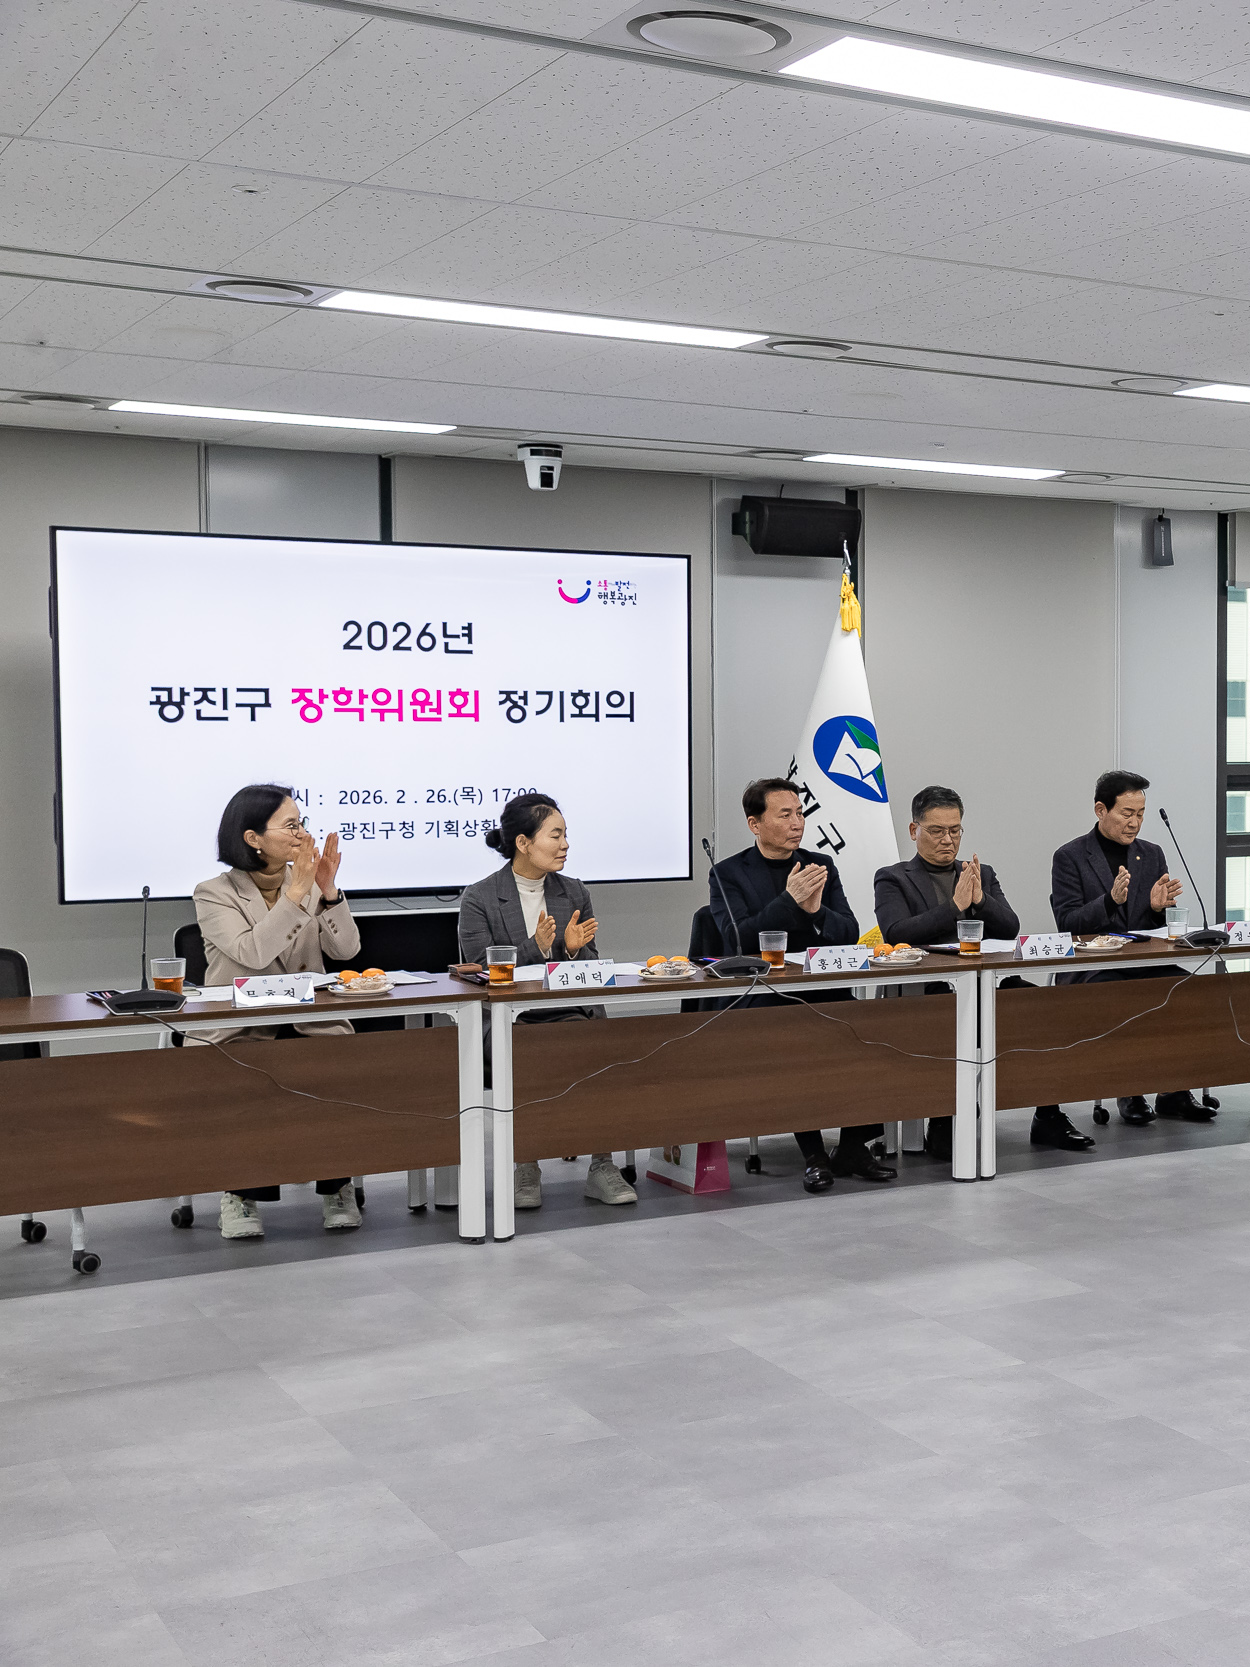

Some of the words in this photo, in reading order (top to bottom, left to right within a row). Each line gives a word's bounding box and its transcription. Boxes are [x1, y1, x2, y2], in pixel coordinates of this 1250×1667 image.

[597, 591, 637, 606] 행복광진
[342, 620, 474, 654] 2026년
[149, 686, 272, 723] 광진구
[291, 686, 480, 723] 장학위원회
[498, 688, 635, 724] 정기회의
[338, 790, 388, 805] 2026.
[338, 821, 415, 841] 광진구청
[424, 819, 502, 838] 기획상황
[818, 957, 858, 971] 홍성근
